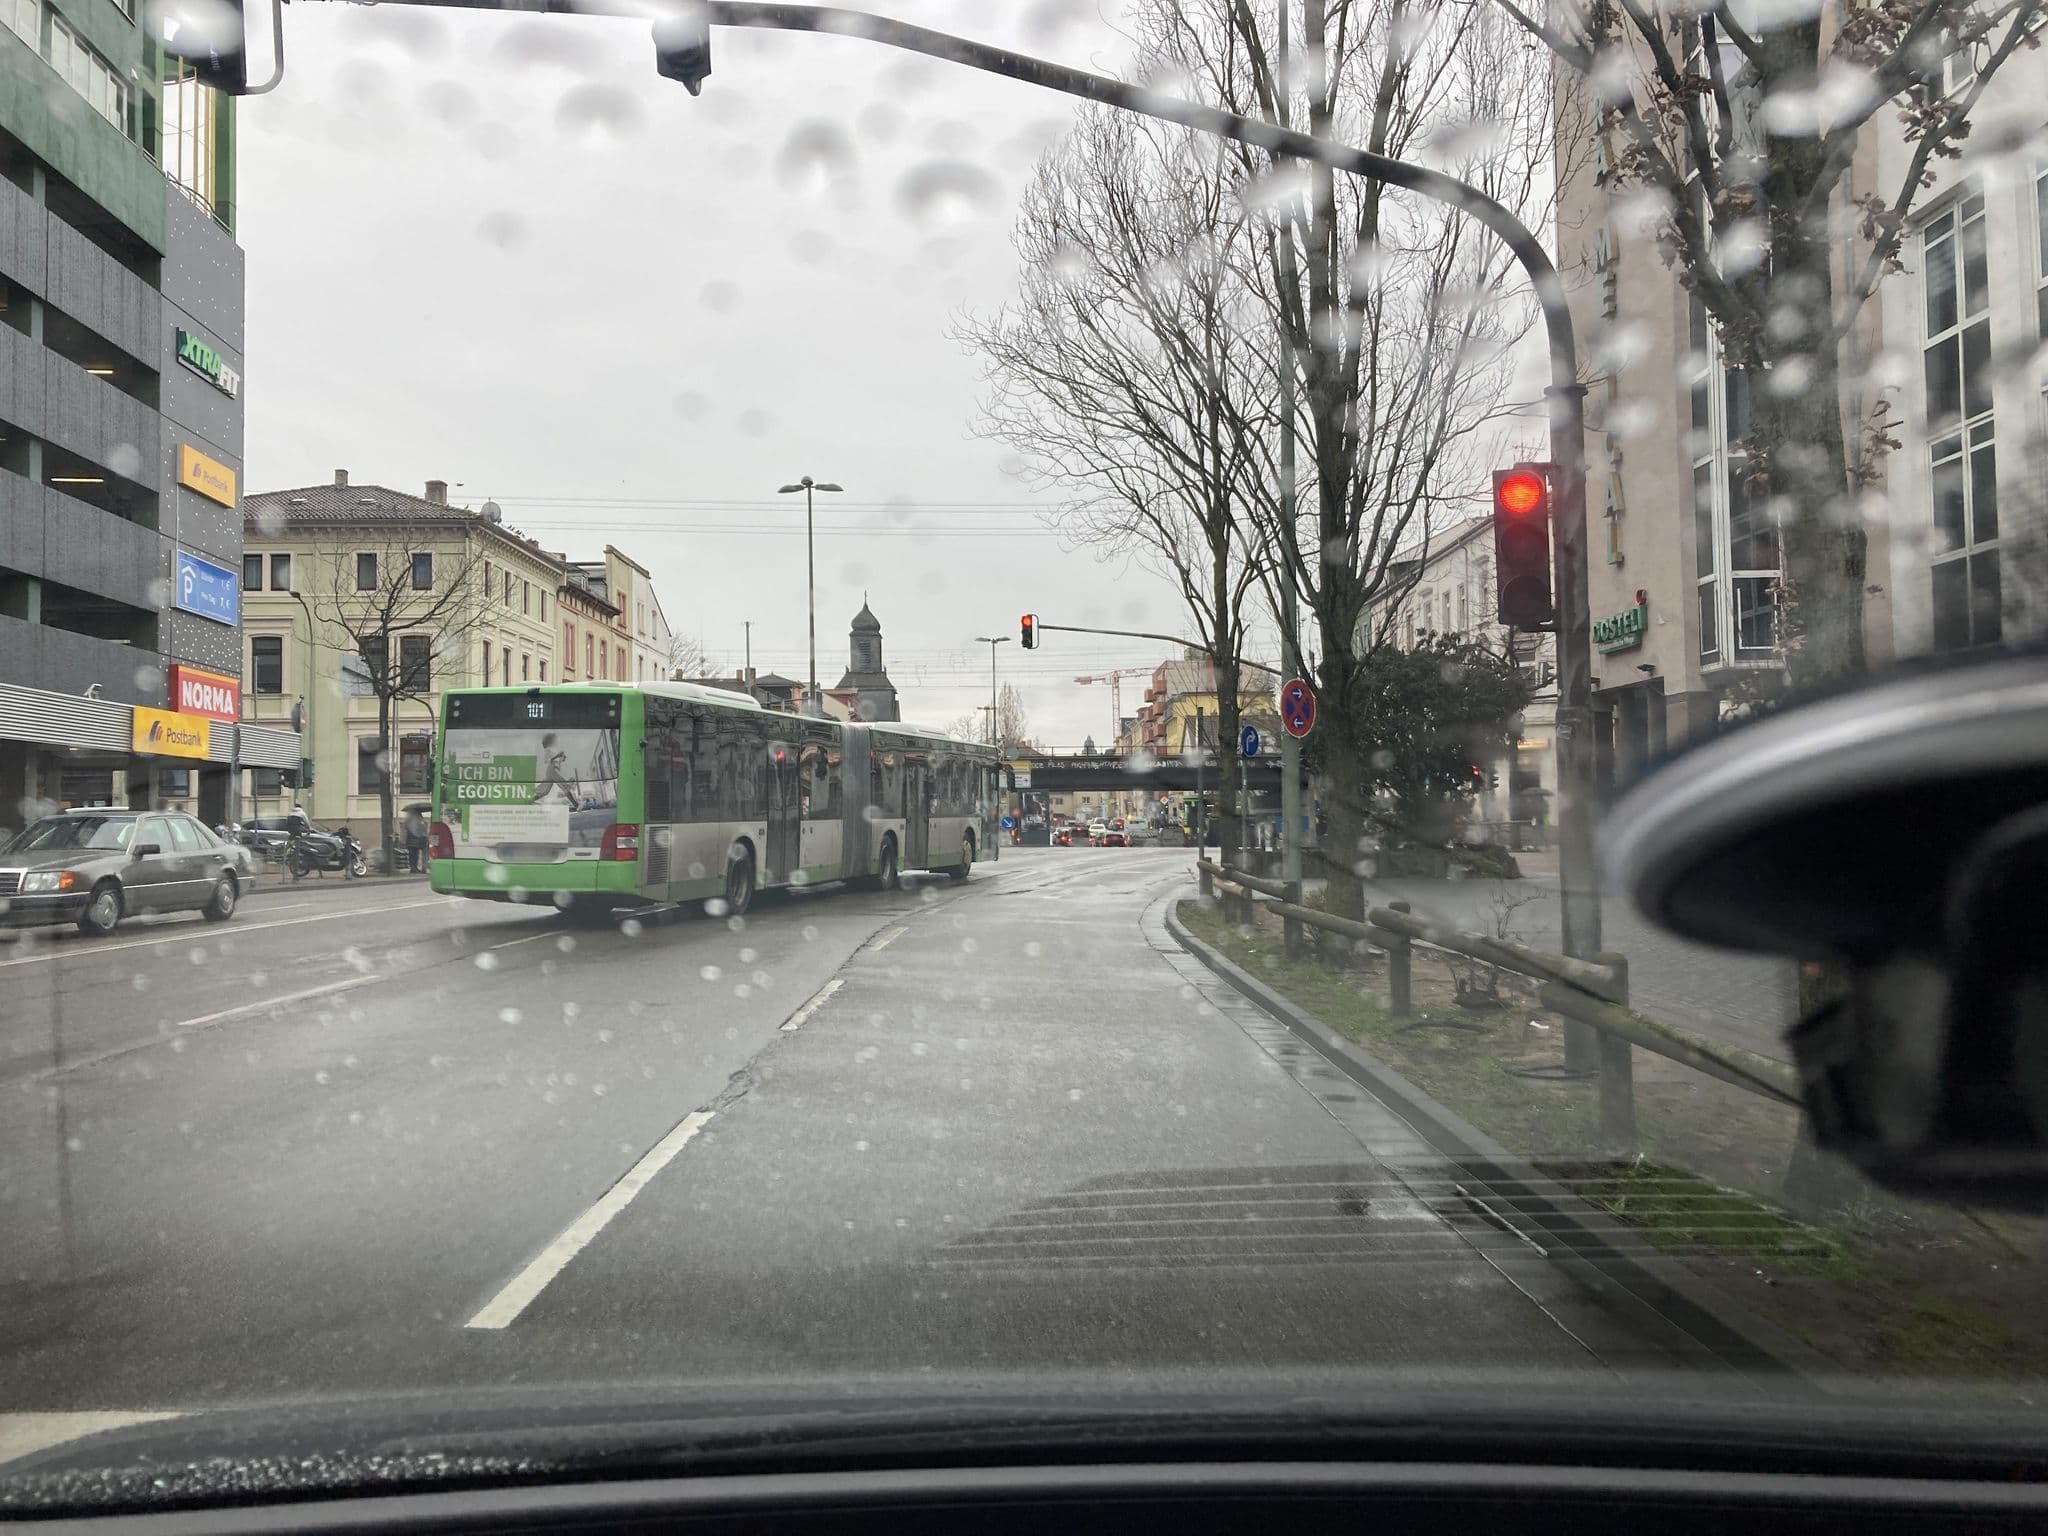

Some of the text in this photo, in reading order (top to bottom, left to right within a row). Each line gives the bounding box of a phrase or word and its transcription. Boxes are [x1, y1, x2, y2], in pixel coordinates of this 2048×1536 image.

[182, 680, 234, 715] NORMA
[527, 702, 544, 718] 101
[166, 727, 202, 747] Postbank
[458, 766, 513, 781] ICH BIN
[457, 784, 532, 799] EGOISTIN.
